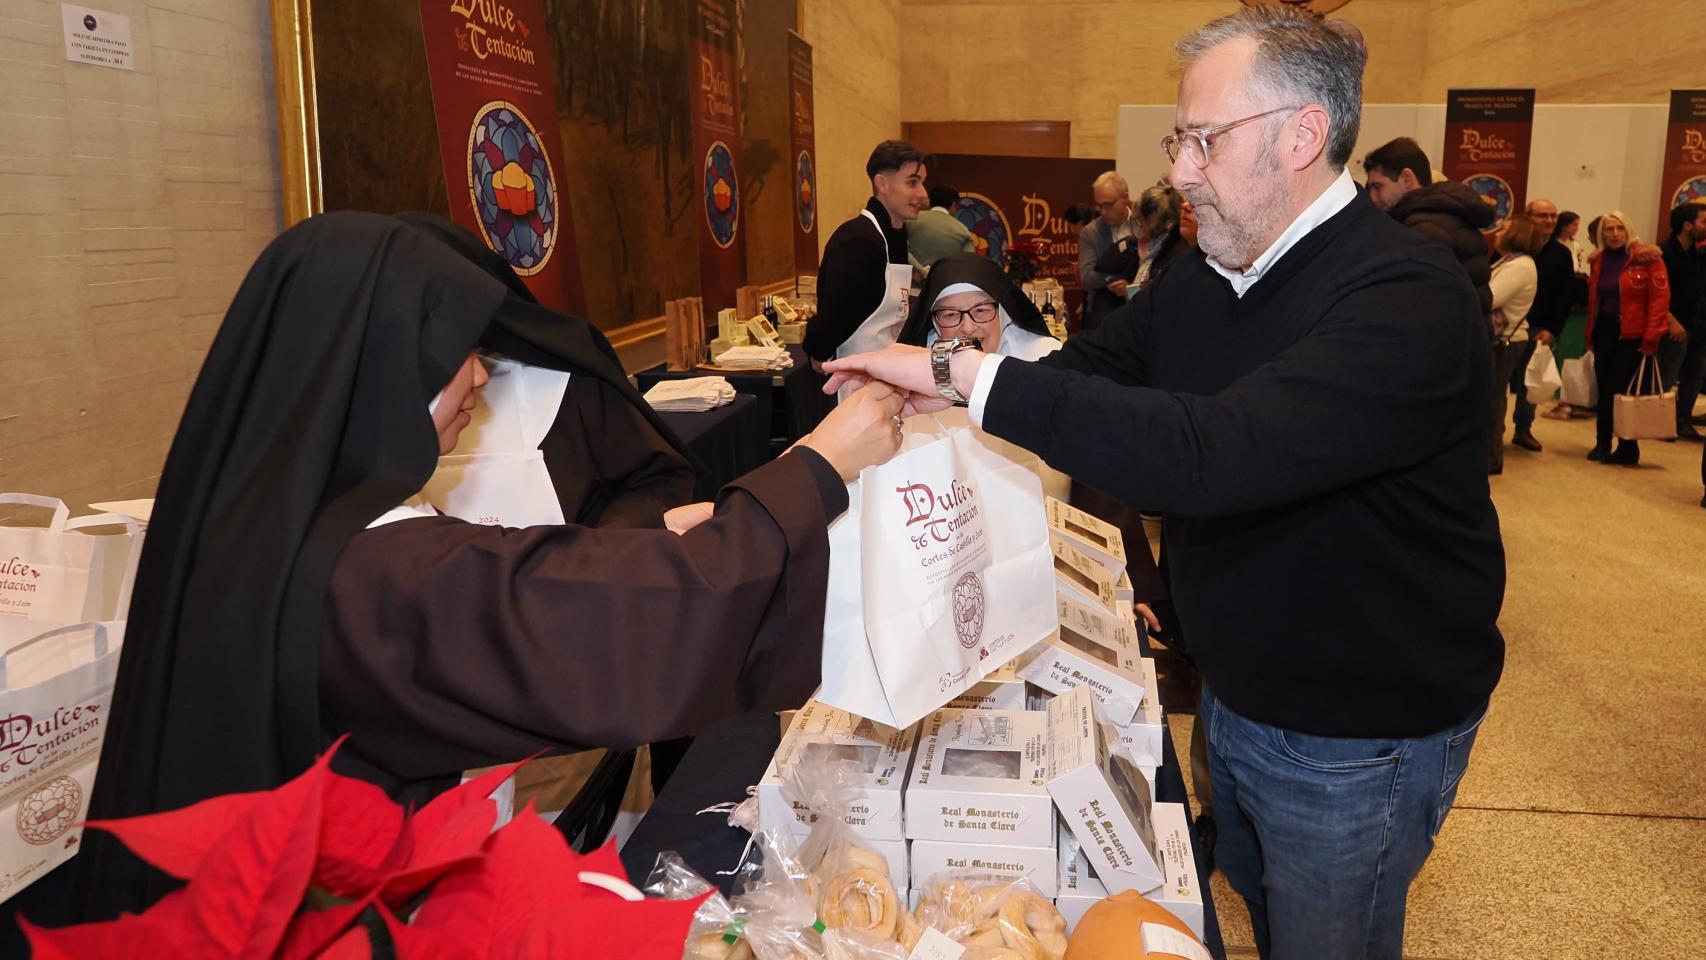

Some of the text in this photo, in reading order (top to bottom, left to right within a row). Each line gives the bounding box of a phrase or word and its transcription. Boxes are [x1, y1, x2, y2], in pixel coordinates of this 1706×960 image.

[465, 20, 535, 65] Tentación
[1460, 128, 1505, 149] Dulce
[1031, 236, 1079, 261] Tenta
[895, 479, 967, 527] Dulce
[921, 552, 948, 567] Cortes
[1050, 671, 1060, 680] de
[1052, 661, 1113, 695] Real Monasterio
[0, 706, 81, 752] Dulce
[11, 717, 99, 766] Tentación
[795, 813, 806, 822] de
[844, 815, 866, 825] Clara
[940, 806, 1019, 820] Real Monasterio
[943, 819, 1016, 832] de Santa Clara
[1078, 807, 1120, 870] de Santa Clara
[1088, 799, 1133, 867] Real Monasterio
[945, 858, 1025, 872] Real Monasterio
